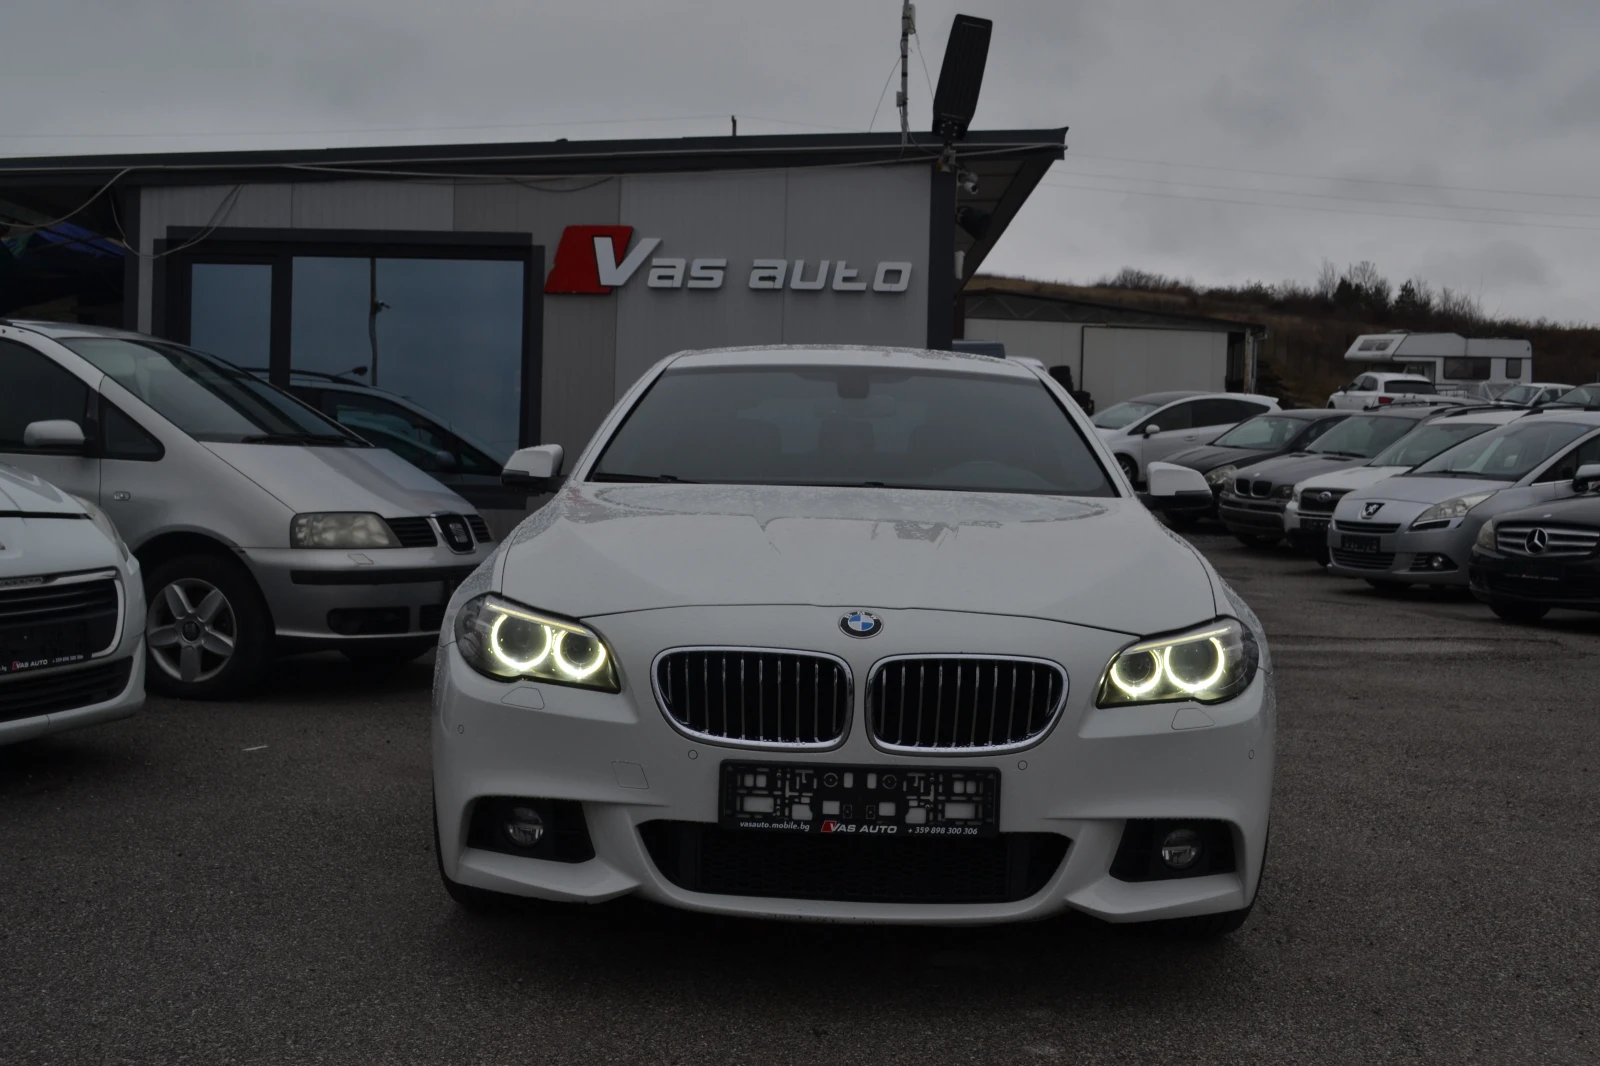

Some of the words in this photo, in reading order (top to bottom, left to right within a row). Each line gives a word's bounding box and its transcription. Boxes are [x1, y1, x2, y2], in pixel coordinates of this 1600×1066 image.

[593, 236, 727, 289] Vas
[748, 258, 912, 292] auto
[30, 659, 48, 667] AUTO
[739, 821, 811, 832] vasauto.mobile.bg
[829, 823, 857, 833] VAS
[859, 825, 898, 834] AUTO
[914, 826, 930, 834] 359
[930, 827, 946, 835] 898
[947, 827, 962, 835] 300
[962, 827, 978, 835] 306
